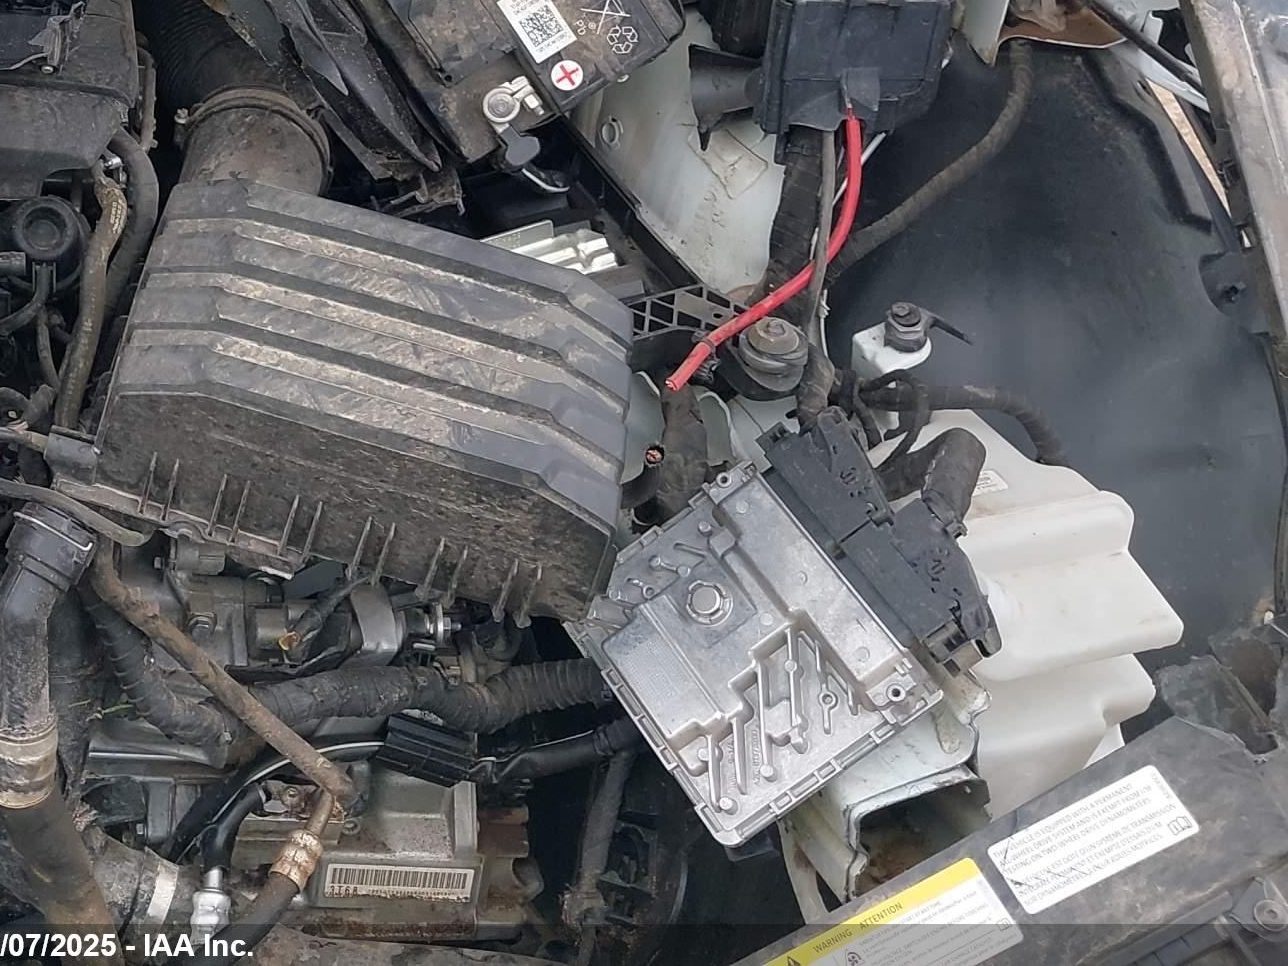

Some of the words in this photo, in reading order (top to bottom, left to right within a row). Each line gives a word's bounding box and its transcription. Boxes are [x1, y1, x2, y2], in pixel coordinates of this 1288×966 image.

[572, 18, 589, 37] Pb
[811, 926, 853, 955] WARNING
[857, 900, 903, 931] ATTENTION
